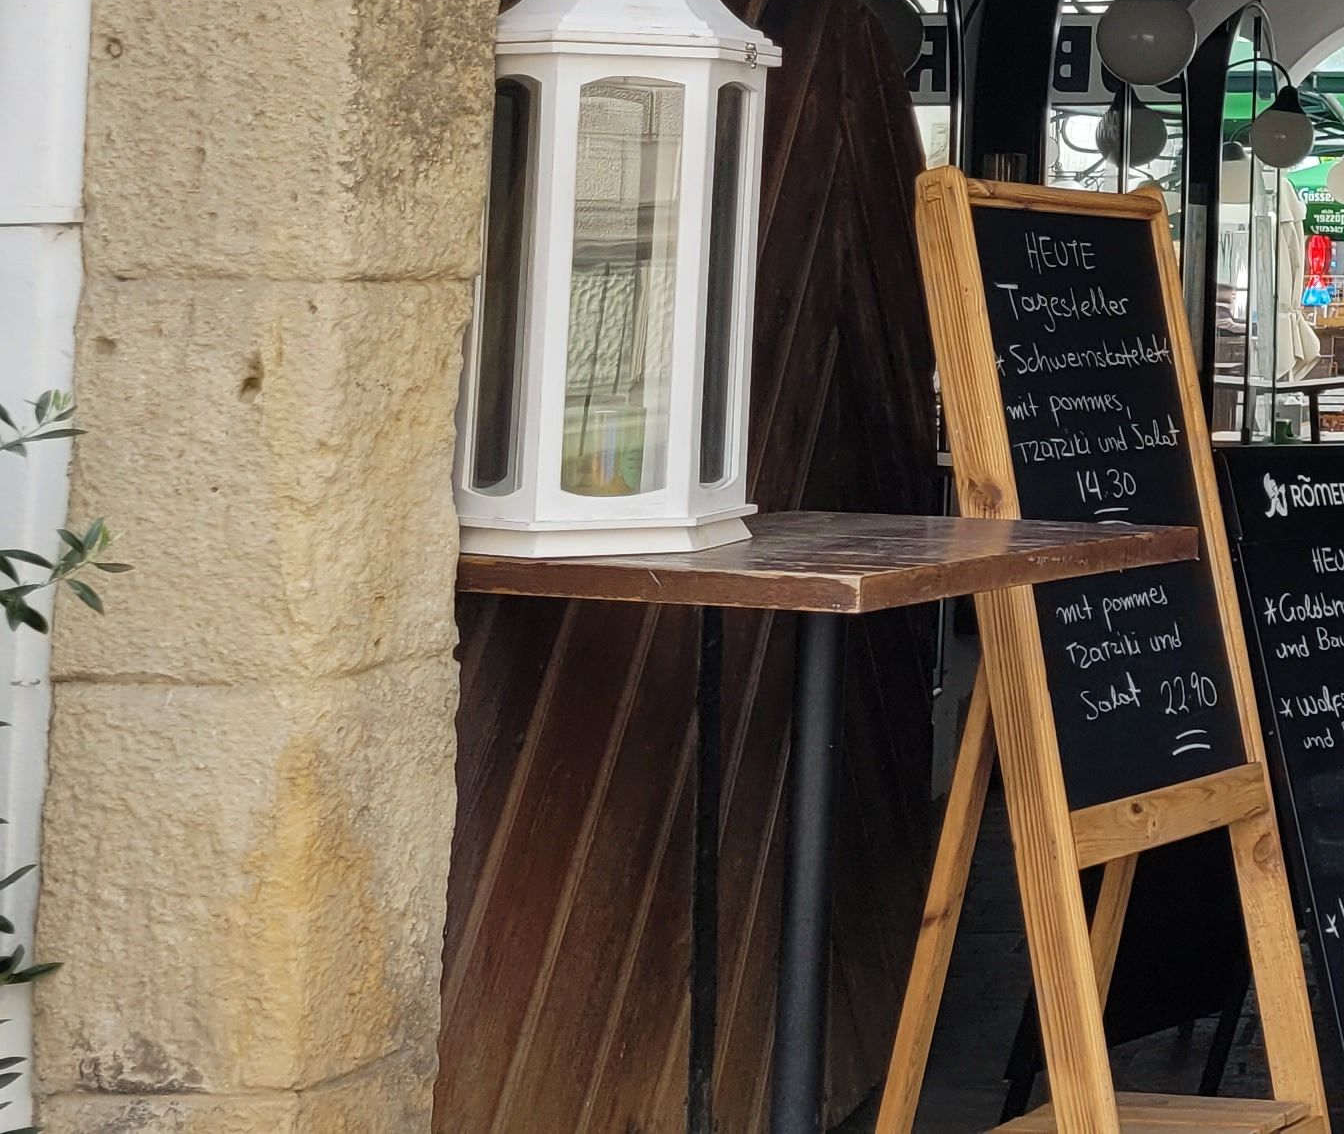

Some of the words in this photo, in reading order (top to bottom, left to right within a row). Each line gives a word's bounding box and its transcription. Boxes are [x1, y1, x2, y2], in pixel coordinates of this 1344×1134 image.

[1024, 232, 1097, 274] HEUTE
[994, 281, 1129, 332] Tagesteller
[1007, 392, 1039, 420] mit
[1099, 433, 1129, 454] und
[1130, 415, 1181, 451] Salat
[1056, 594, 1093, 624] mit
[1102, 584, 1168, 632] pommes
[1150, 621, 1183, 652] und
[1276, 635, 1310, 659] und
[1080, 671, 1142, 721] Salat
[1303, 727, 1334, 749] und
